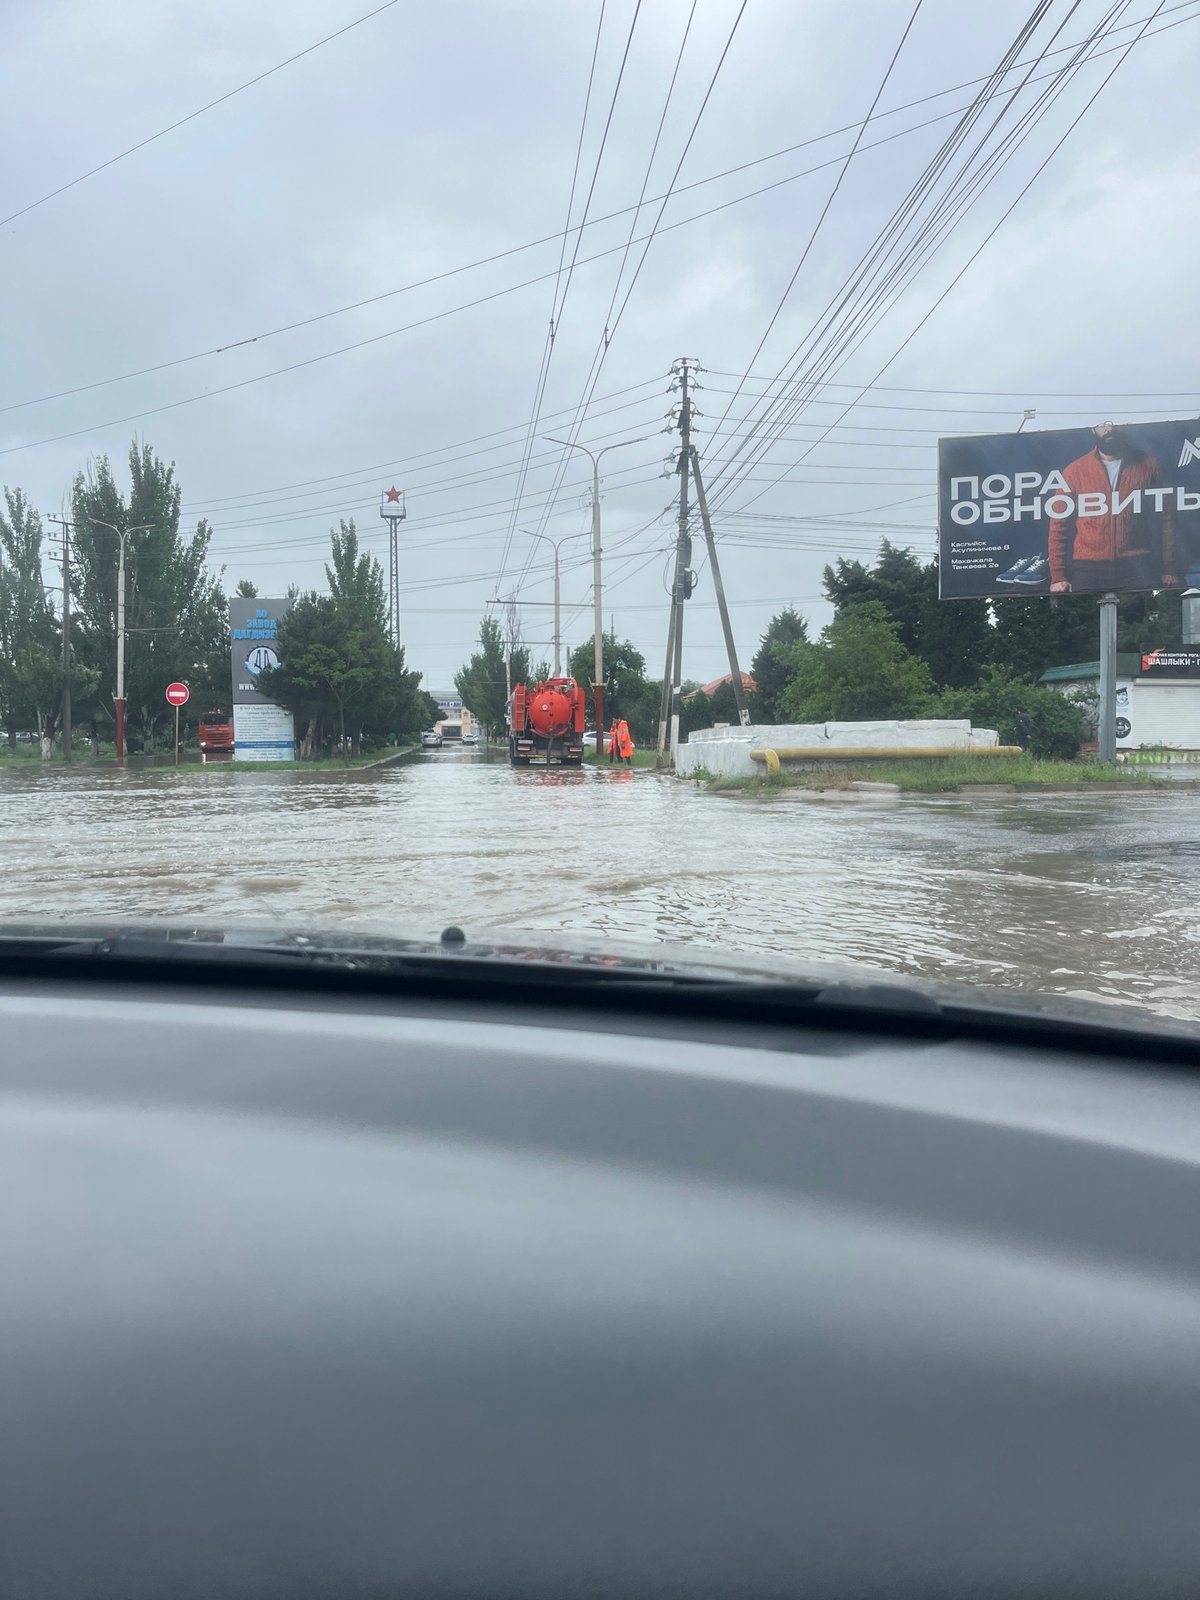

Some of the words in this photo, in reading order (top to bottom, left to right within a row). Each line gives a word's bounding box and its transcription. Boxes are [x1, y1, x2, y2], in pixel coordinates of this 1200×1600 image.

[951, 470, 1072, 500] ПОРА
[951, 486, 1200, 525] ОБНОВИТЬ
[233, 628, 277, 640] ДАГДИЗЕ
